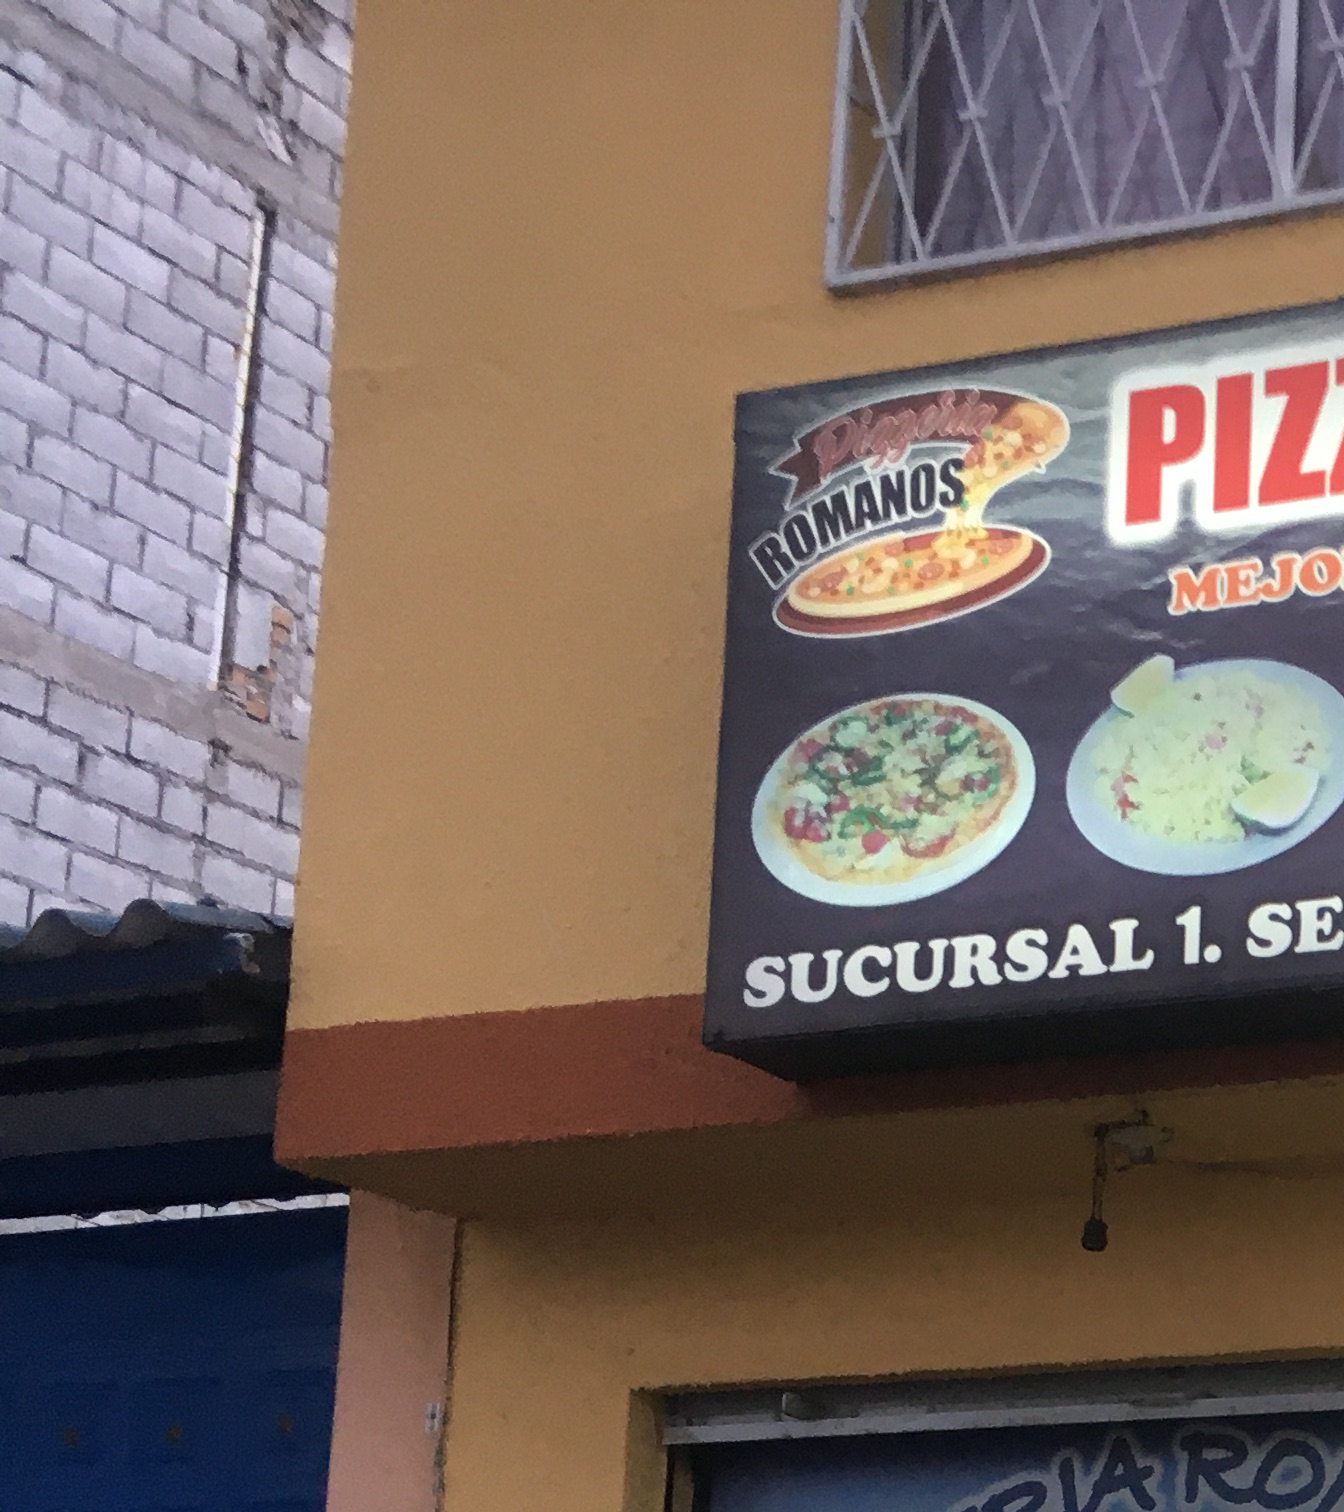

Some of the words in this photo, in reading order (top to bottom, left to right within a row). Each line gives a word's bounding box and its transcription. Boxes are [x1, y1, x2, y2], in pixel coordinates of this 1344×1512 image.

[752, 458, 965, 588] ROMANOS
[743, 917, 1154, 1008] SUCURSAL
[1177, 907, 1222, 964] 1.
